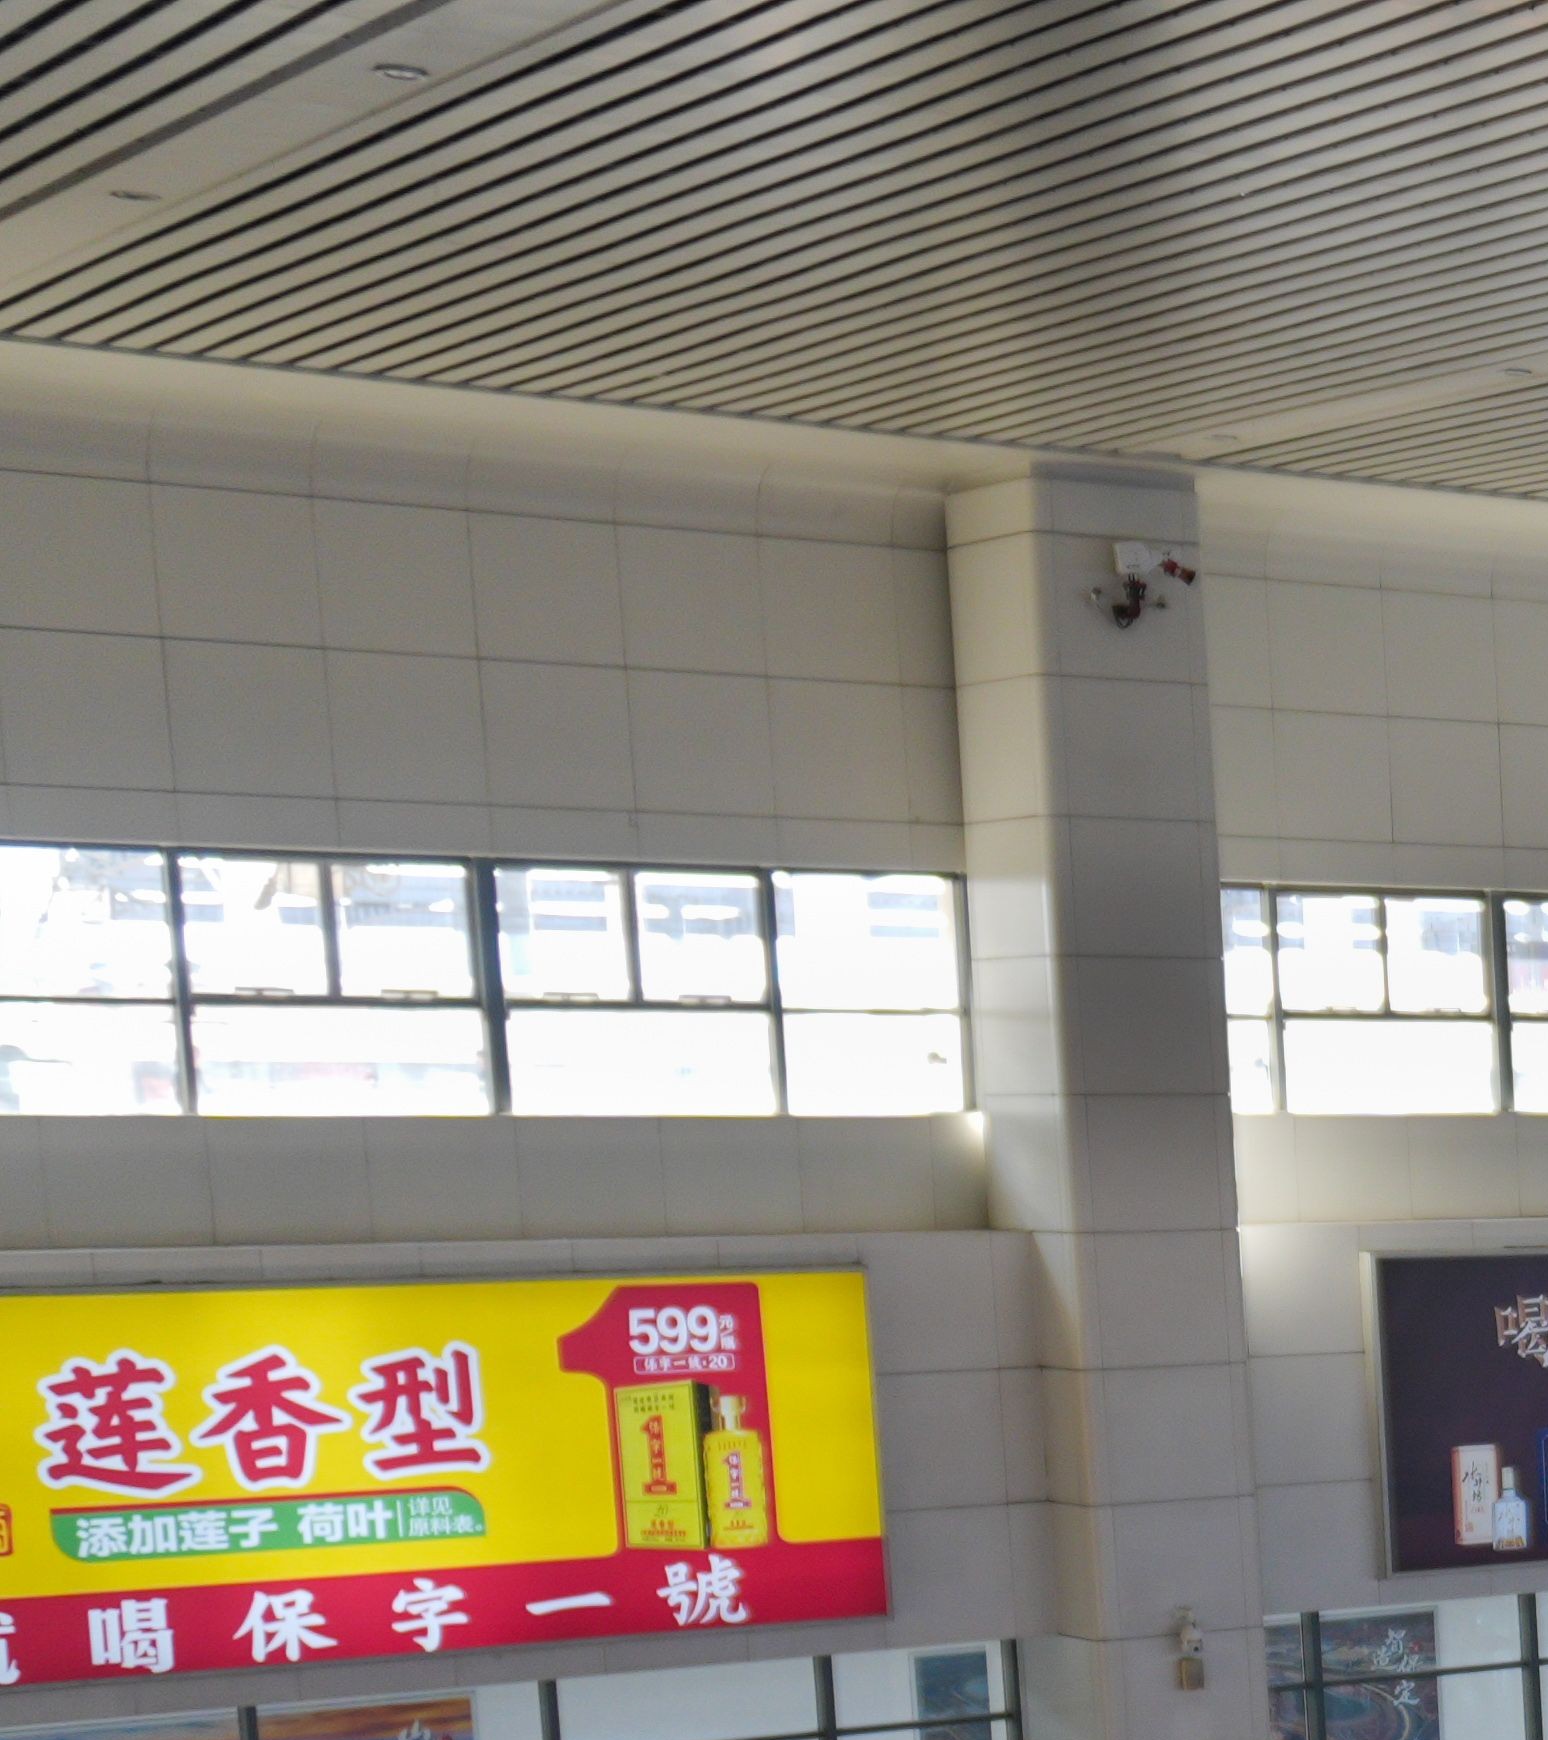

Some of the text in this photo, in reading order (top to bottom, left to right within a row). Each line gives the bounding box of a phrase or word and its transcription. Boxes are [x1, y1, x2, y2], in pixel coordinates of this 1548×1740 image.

[629, 1306, 720, 1355] 599
[41, 1345, 487, 1493] 莲香型
[76, 1500, 393, 1558] 添加莲子 荷叶
